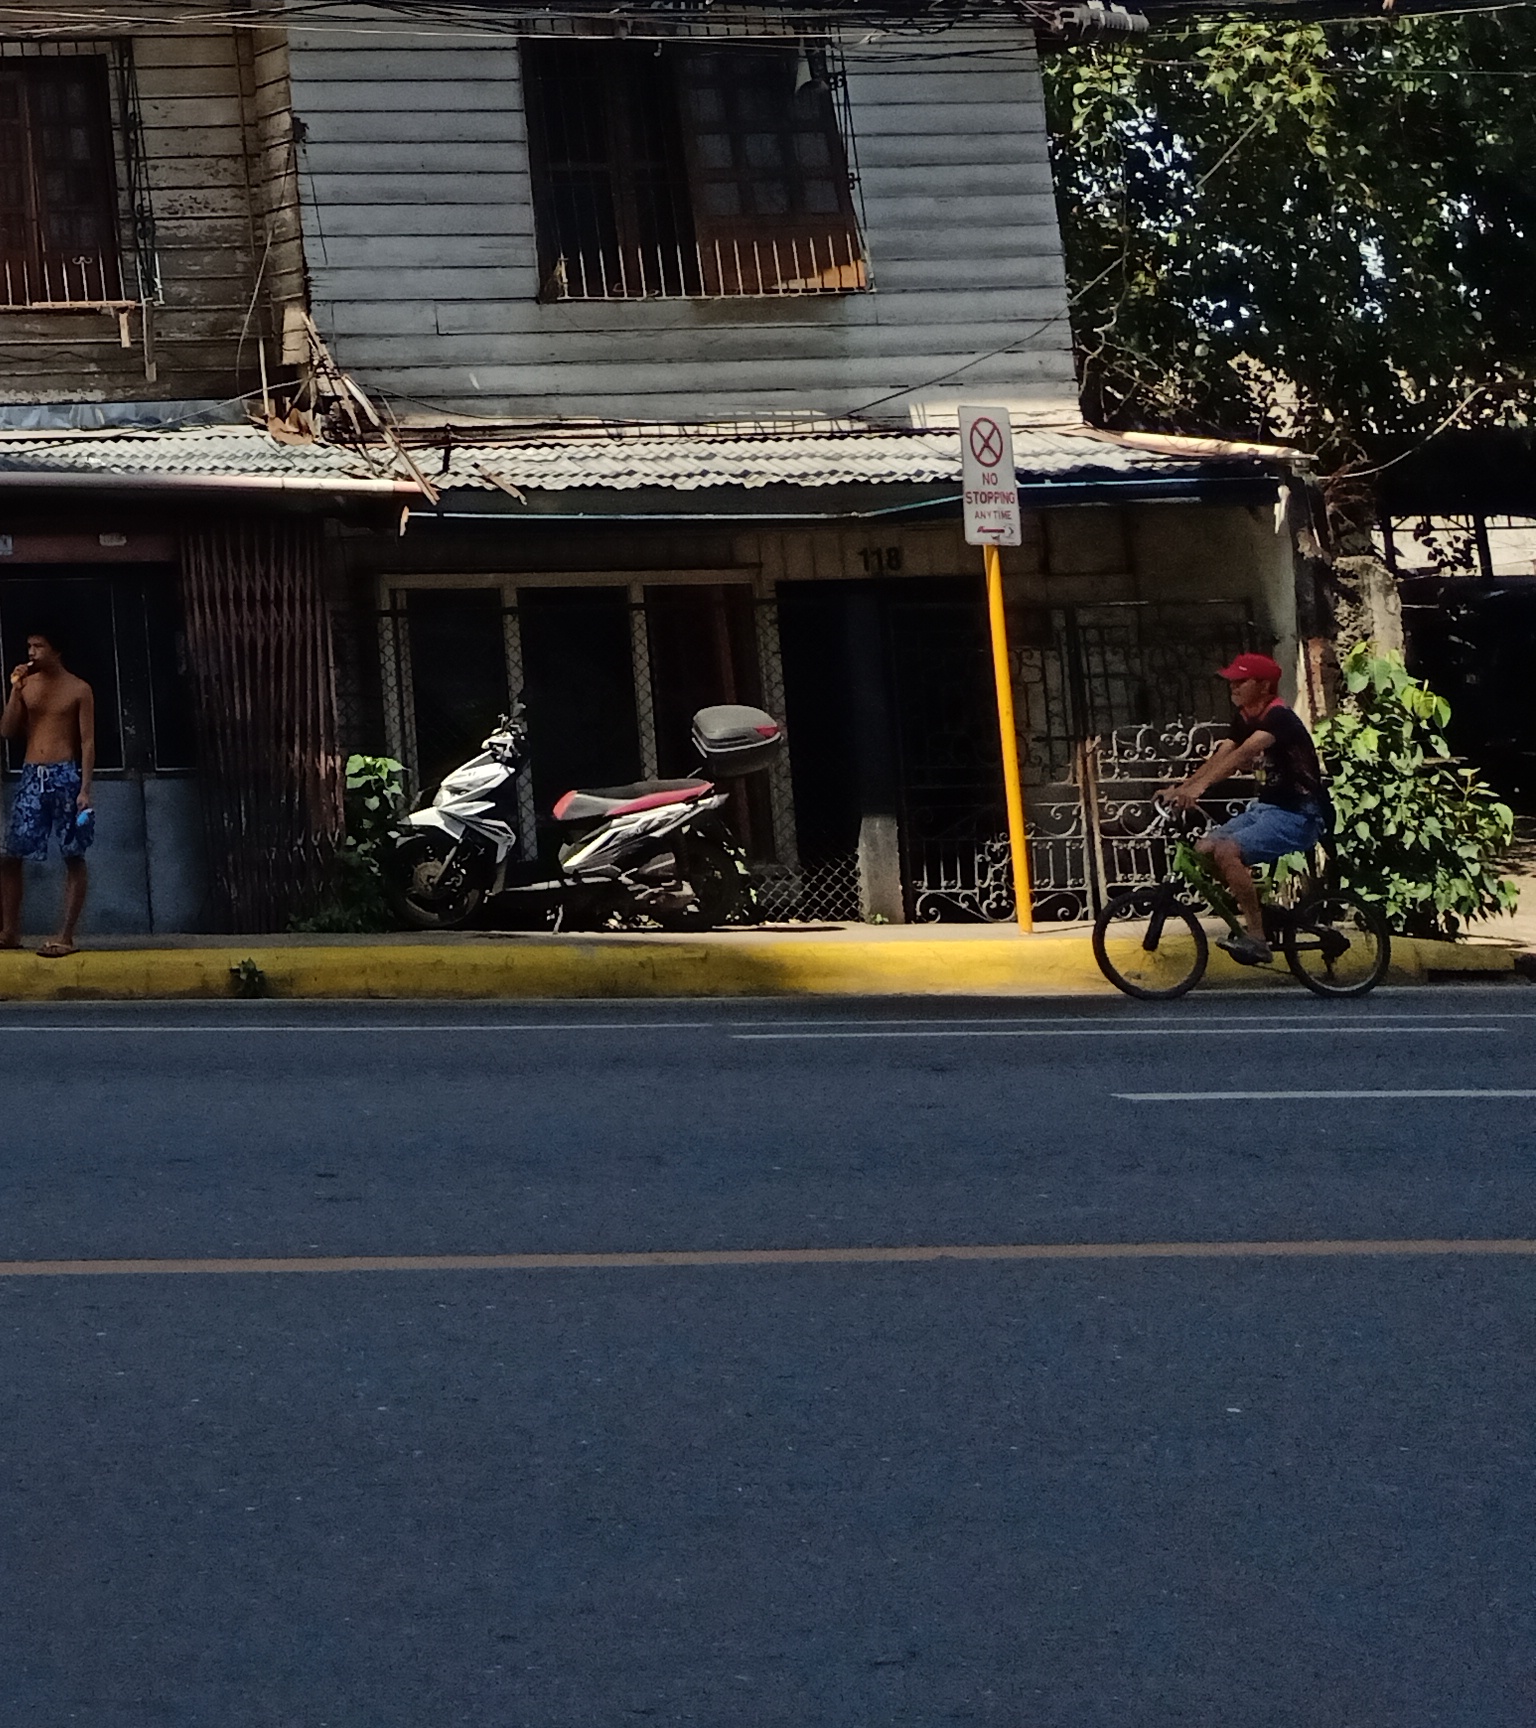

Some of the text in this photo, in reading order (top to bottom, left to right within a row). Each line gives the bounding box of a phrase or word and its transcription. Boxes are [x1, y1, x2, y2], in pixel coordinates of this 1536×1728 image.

[982, 472, 999, 486] NO
[965, 491, 1016, 505] STOPPING
[974, 510, 1012, 520] ANYTIME
[857, 546, 902, 572] 118
